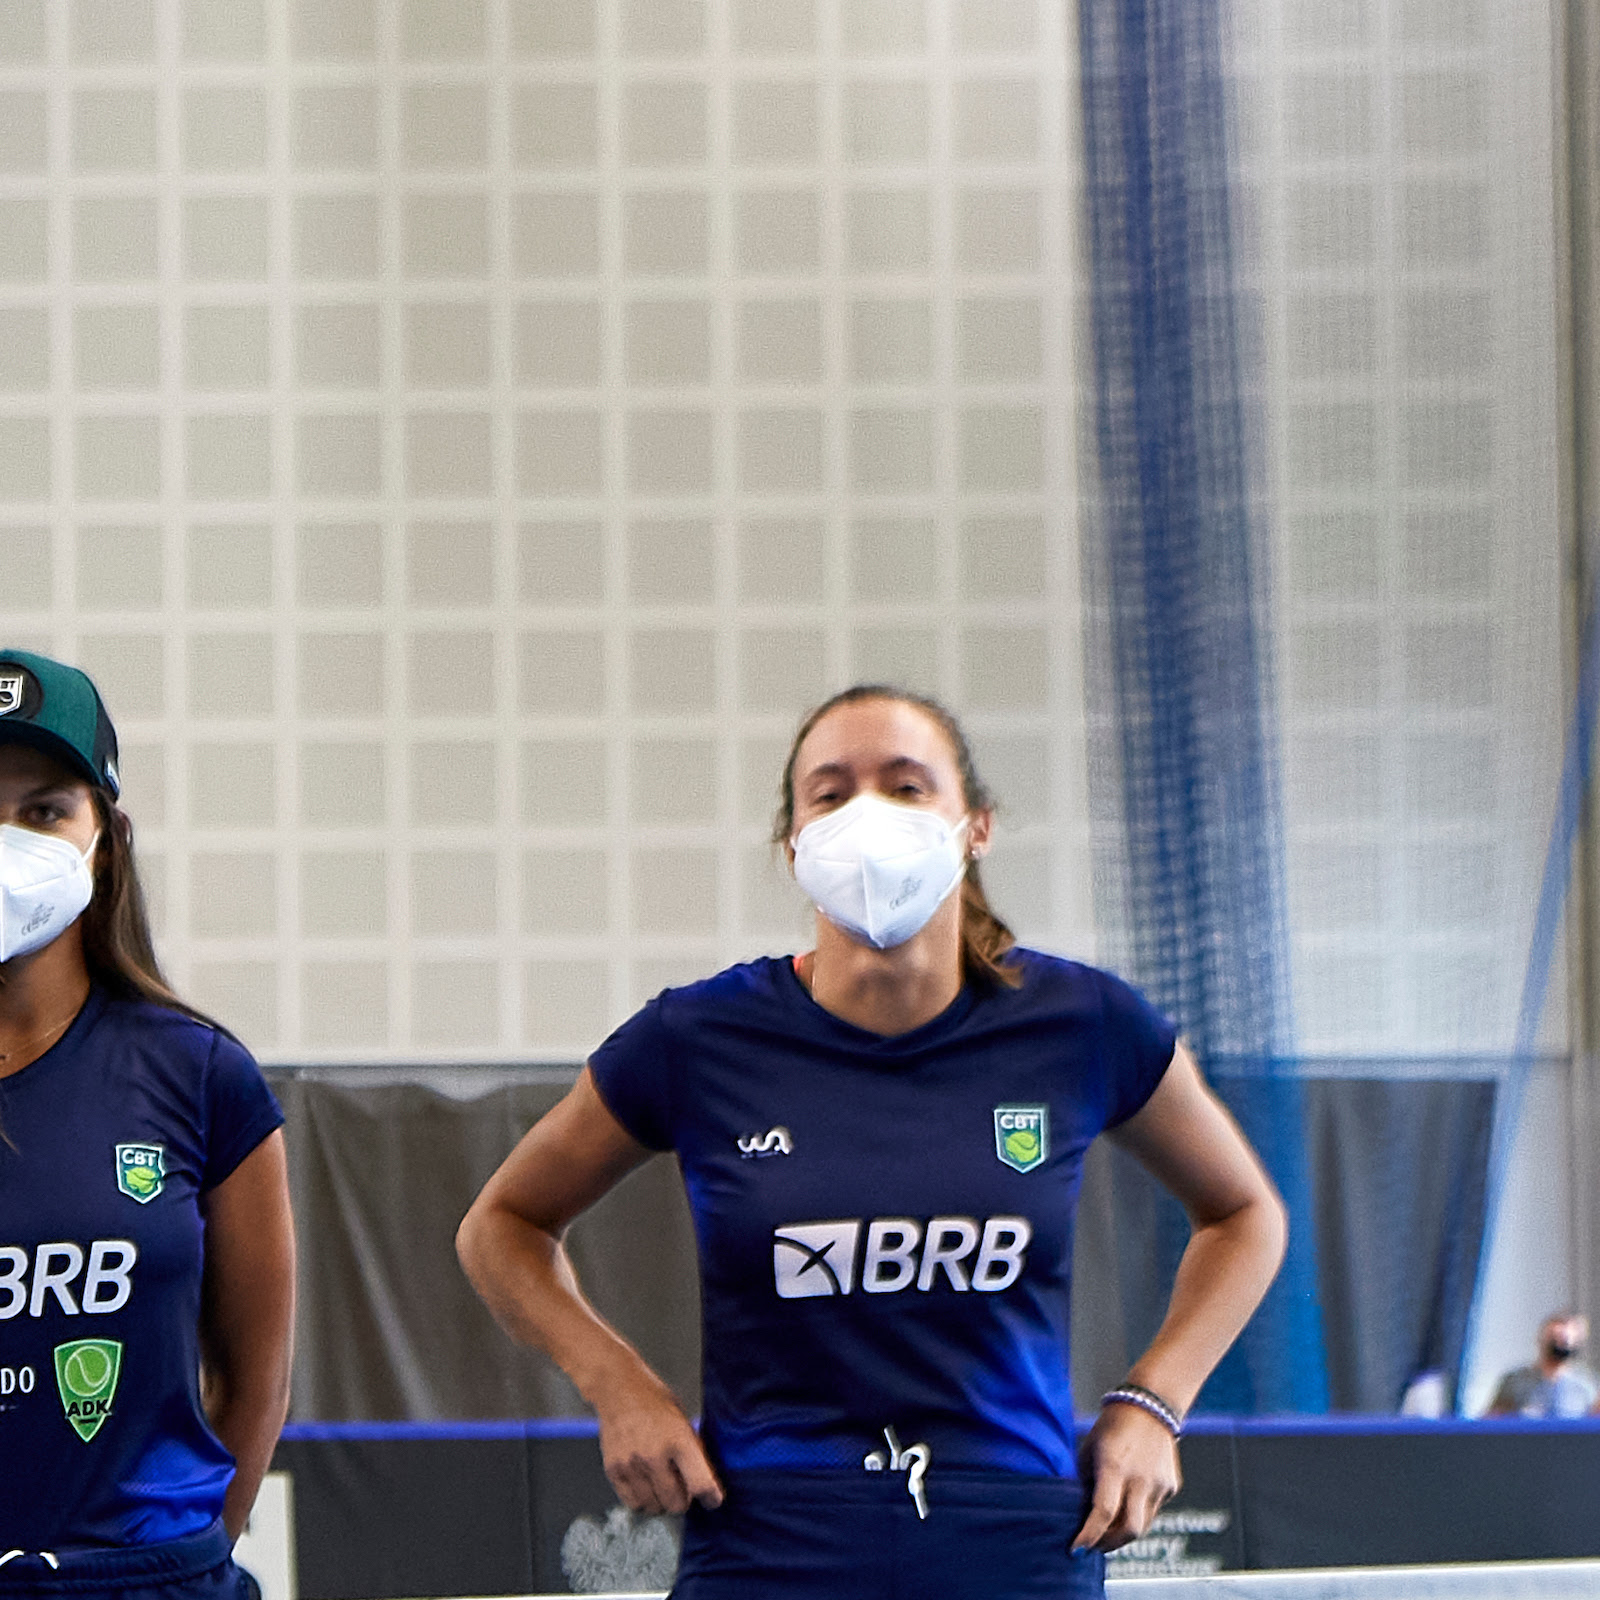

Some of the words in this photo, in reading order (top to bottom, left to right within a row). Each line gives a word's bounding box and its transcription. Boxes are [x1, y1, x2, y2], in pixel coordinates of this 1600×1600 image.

[1000, 1113, 1039, 1130] CBT
[122, 1148, 157, 1167] CBT
[862, 1217, 1031, 1294] BRB
[67, 1399, 109, 1418] ADK
